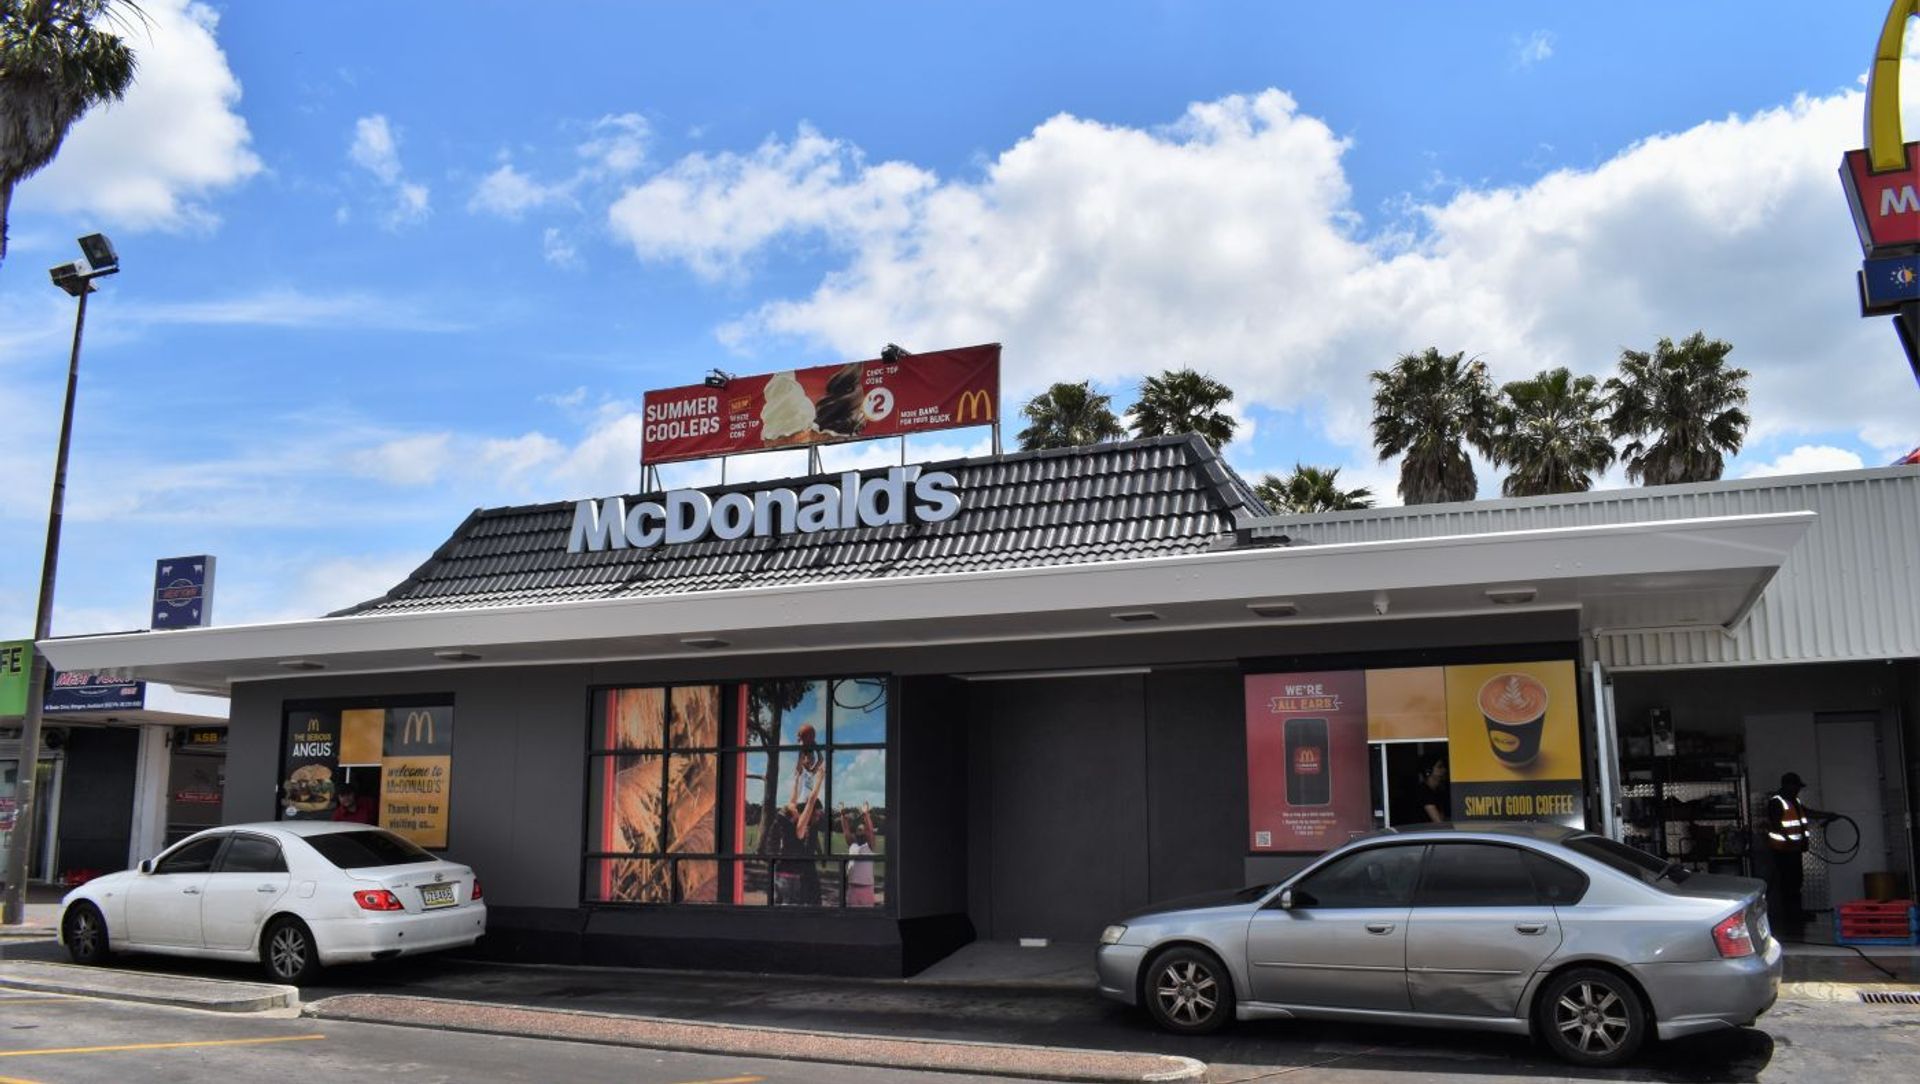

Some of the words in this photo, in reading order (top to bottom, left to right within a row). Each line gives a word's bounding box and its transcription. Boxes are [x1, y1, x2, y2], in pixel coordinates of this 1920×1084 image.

[646, 396, 719, 422] SUMMER
[929, 414, 951, 424] BUCK
[645, 416, 720, 442] COOLERS
[567, 465, 961, 554] McDonald's
[1285, 684, 1323, 696] WE'RE
[1278, 699, 1297, 710] ALL
[1300, 698, 1332, 709] EARS
[292, 741, 331, 757] ANGUS
[387, 764, 431, 777] welcome
[388, 803, 410, 814] Thank
[1464, 796, 1503, 816] SIMPLY
[1505, 795, 1533, 815] GOOD
[1535, 794, 1574, 815] COFFEE
